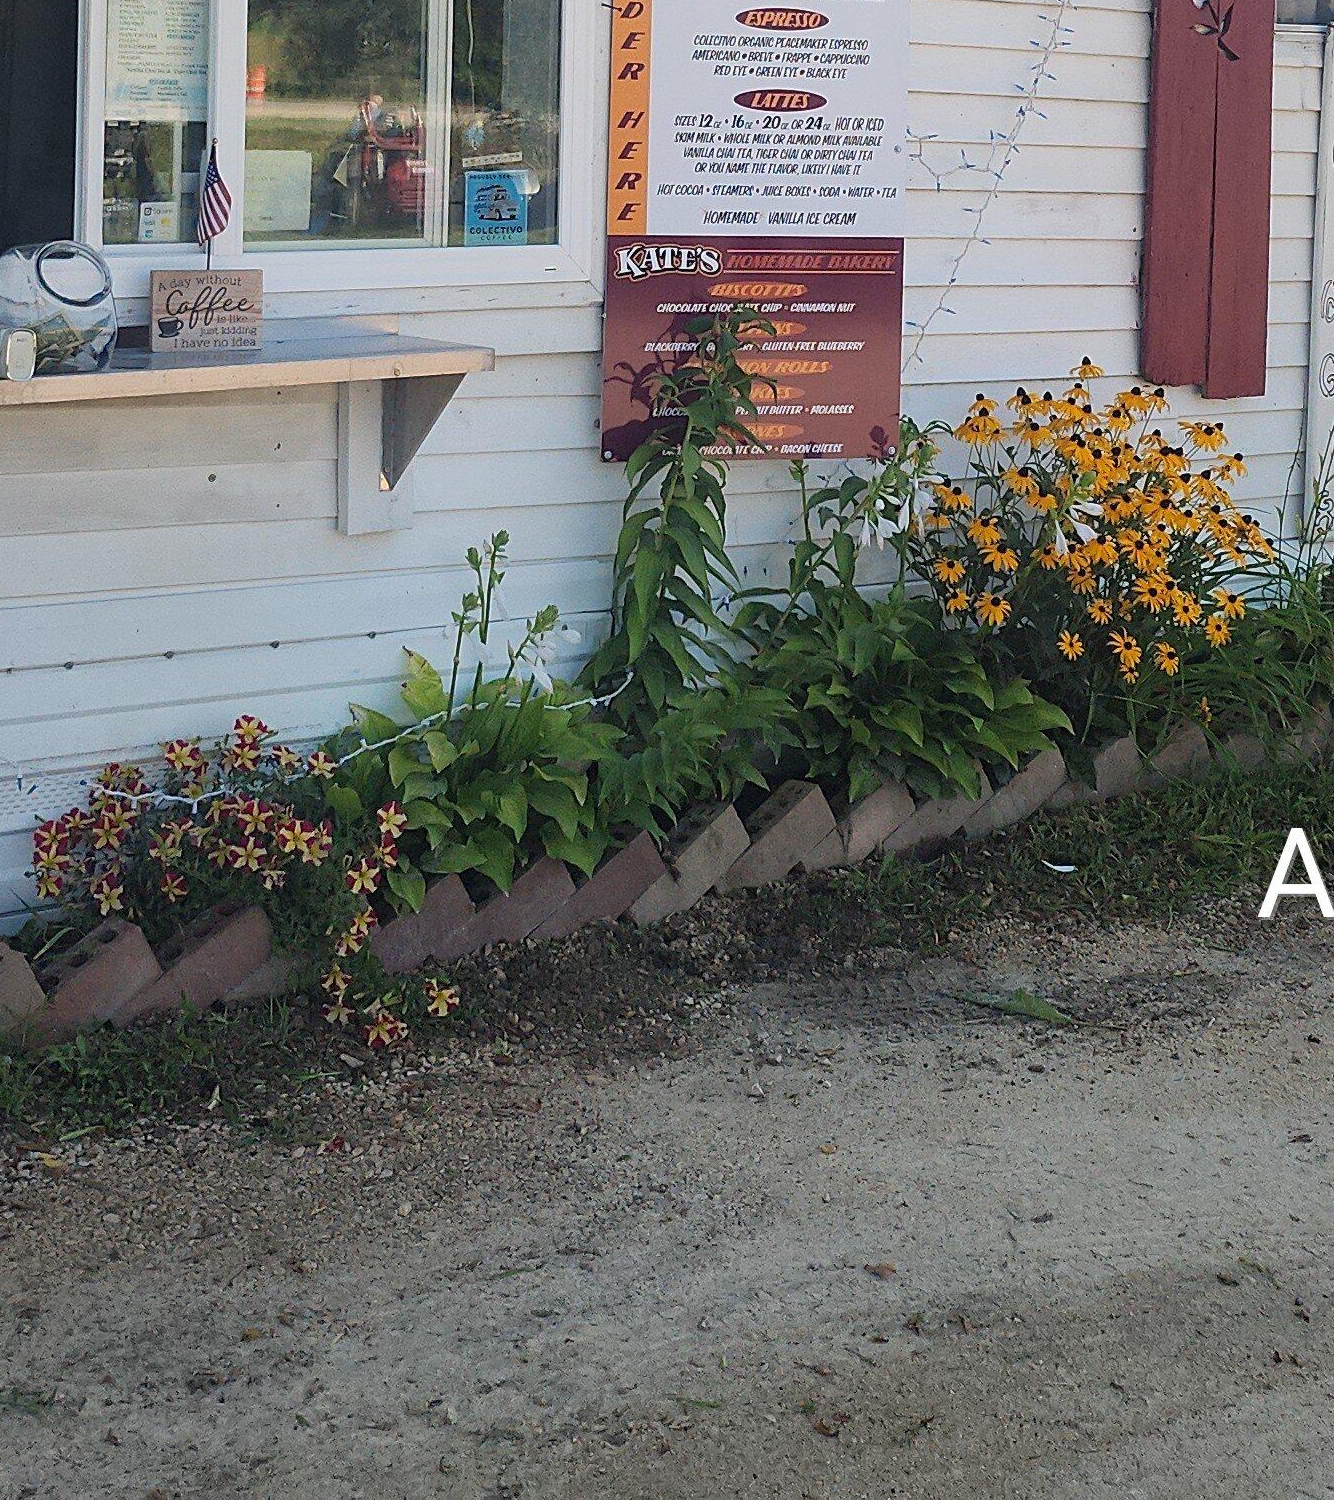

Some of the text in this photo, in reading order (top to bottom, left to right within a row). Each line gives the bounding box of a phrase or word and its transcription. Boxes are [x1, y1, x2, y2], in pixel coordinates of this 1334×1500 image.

[745, 10, 821, 28] ESPRESSO
[693, 35, 869, 50] COLECTIVO ORGANIC PEACEMAKER ESPRESSO
[692, 50, 870, 65] AMERICANO BREVE FRAPPE CAPPUCCINO
[714, 65, 847, 79] RED EYE GREEN EYE BLACK EYE
[751, 93, 811, 109] LATTES
[673, 115, 697, 127] SIZES
[791, 120, 804, 130] OR
[835, 117, 851, 131] HOT
[852, 118, 864, 131] OR
[866, 118, 884, 131] ICED
[674, 132, 883, 146] SKIM MILK WHOLE MILK OR ALMOND MILK AVAILABLE
[683, 147, 873, 161] VANILLA CHAI TEA, TIGER CHAI OR DIRTY CHAI TEA
[694, 162, 707, 173] OR
[708, 162, 725, 173] YOU
[726, 162, 750, 174] NAME
[752, 163, 766, 174] THE
[768, 164, 800, 175] FLAVOR,
[801, 164, 827, 175] LIKELY
[831, 164, 852, 175] HAVE
[852, 164, 861, 176] IT
[657, 184, 897, 198] HOT COCOA STEAMERS JUICE BOXES SODA WATER TEA
[703, 211, 857, 225] HOMEMADE VANILLA ICE CREAM
[469, 225, 523, 234] COLECTIVO
[615, 244, 896, 280] KATE'S HOMEMADE BAKERY
[158, 275, 241, 291] A day without
[166, 286, 254, 329] Coffee
[657, 303, 856, 312] CHOCOLATE CHIP CINNAMON NUT
[199, 326, 257, 337] just kidding
[174, 339, 177, 348] I
[181, 338, 210, 348] have
[214, 339, 229, 347] no
[645, 342, 700, 351] BLACKBERRY
[762, 342, 816, 351] GLUTEN-FREE
[817, 342, 865, 351] BLUEBERRY
[774, 361, 830, 373] ROLLS
[769, 405, 855, 415] BUTTER MOLASSES
[780, 444, 812, 453] BACON
[812, 443, 844, 452] CHEESE
